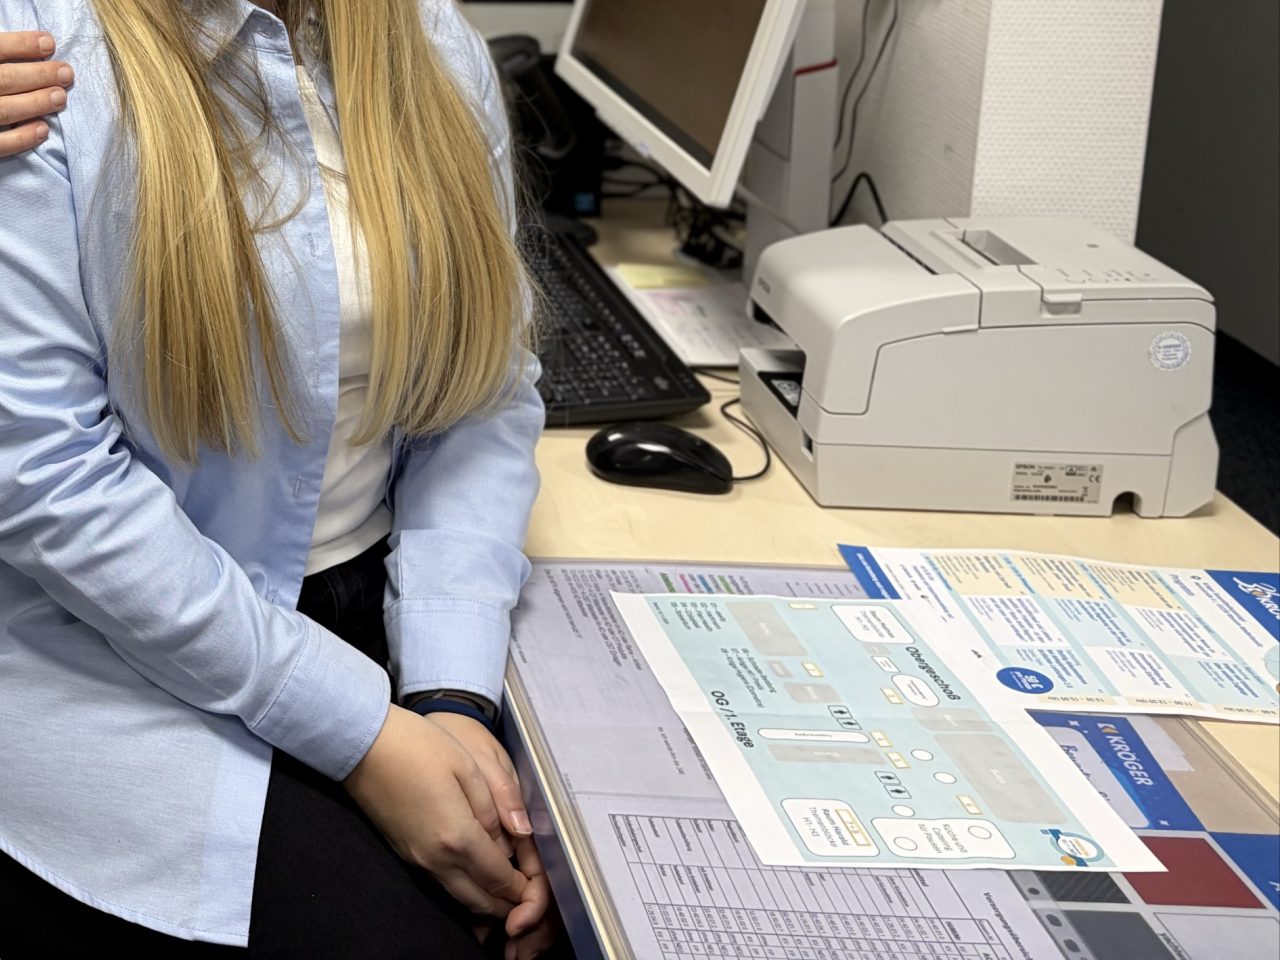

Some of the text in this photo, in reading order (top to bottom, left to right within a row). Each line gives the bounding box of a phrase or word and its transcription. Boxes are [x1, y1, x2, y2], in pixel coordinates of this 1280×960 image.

[904, 646, 962, 700] Obergeschoß
[710, 690, 730, 706] OG
[730, 722, 755, 749] Etage
[1106, 735, 1153, 786] KRÖGER
[822, 808, 851, 845] Raum Harald
